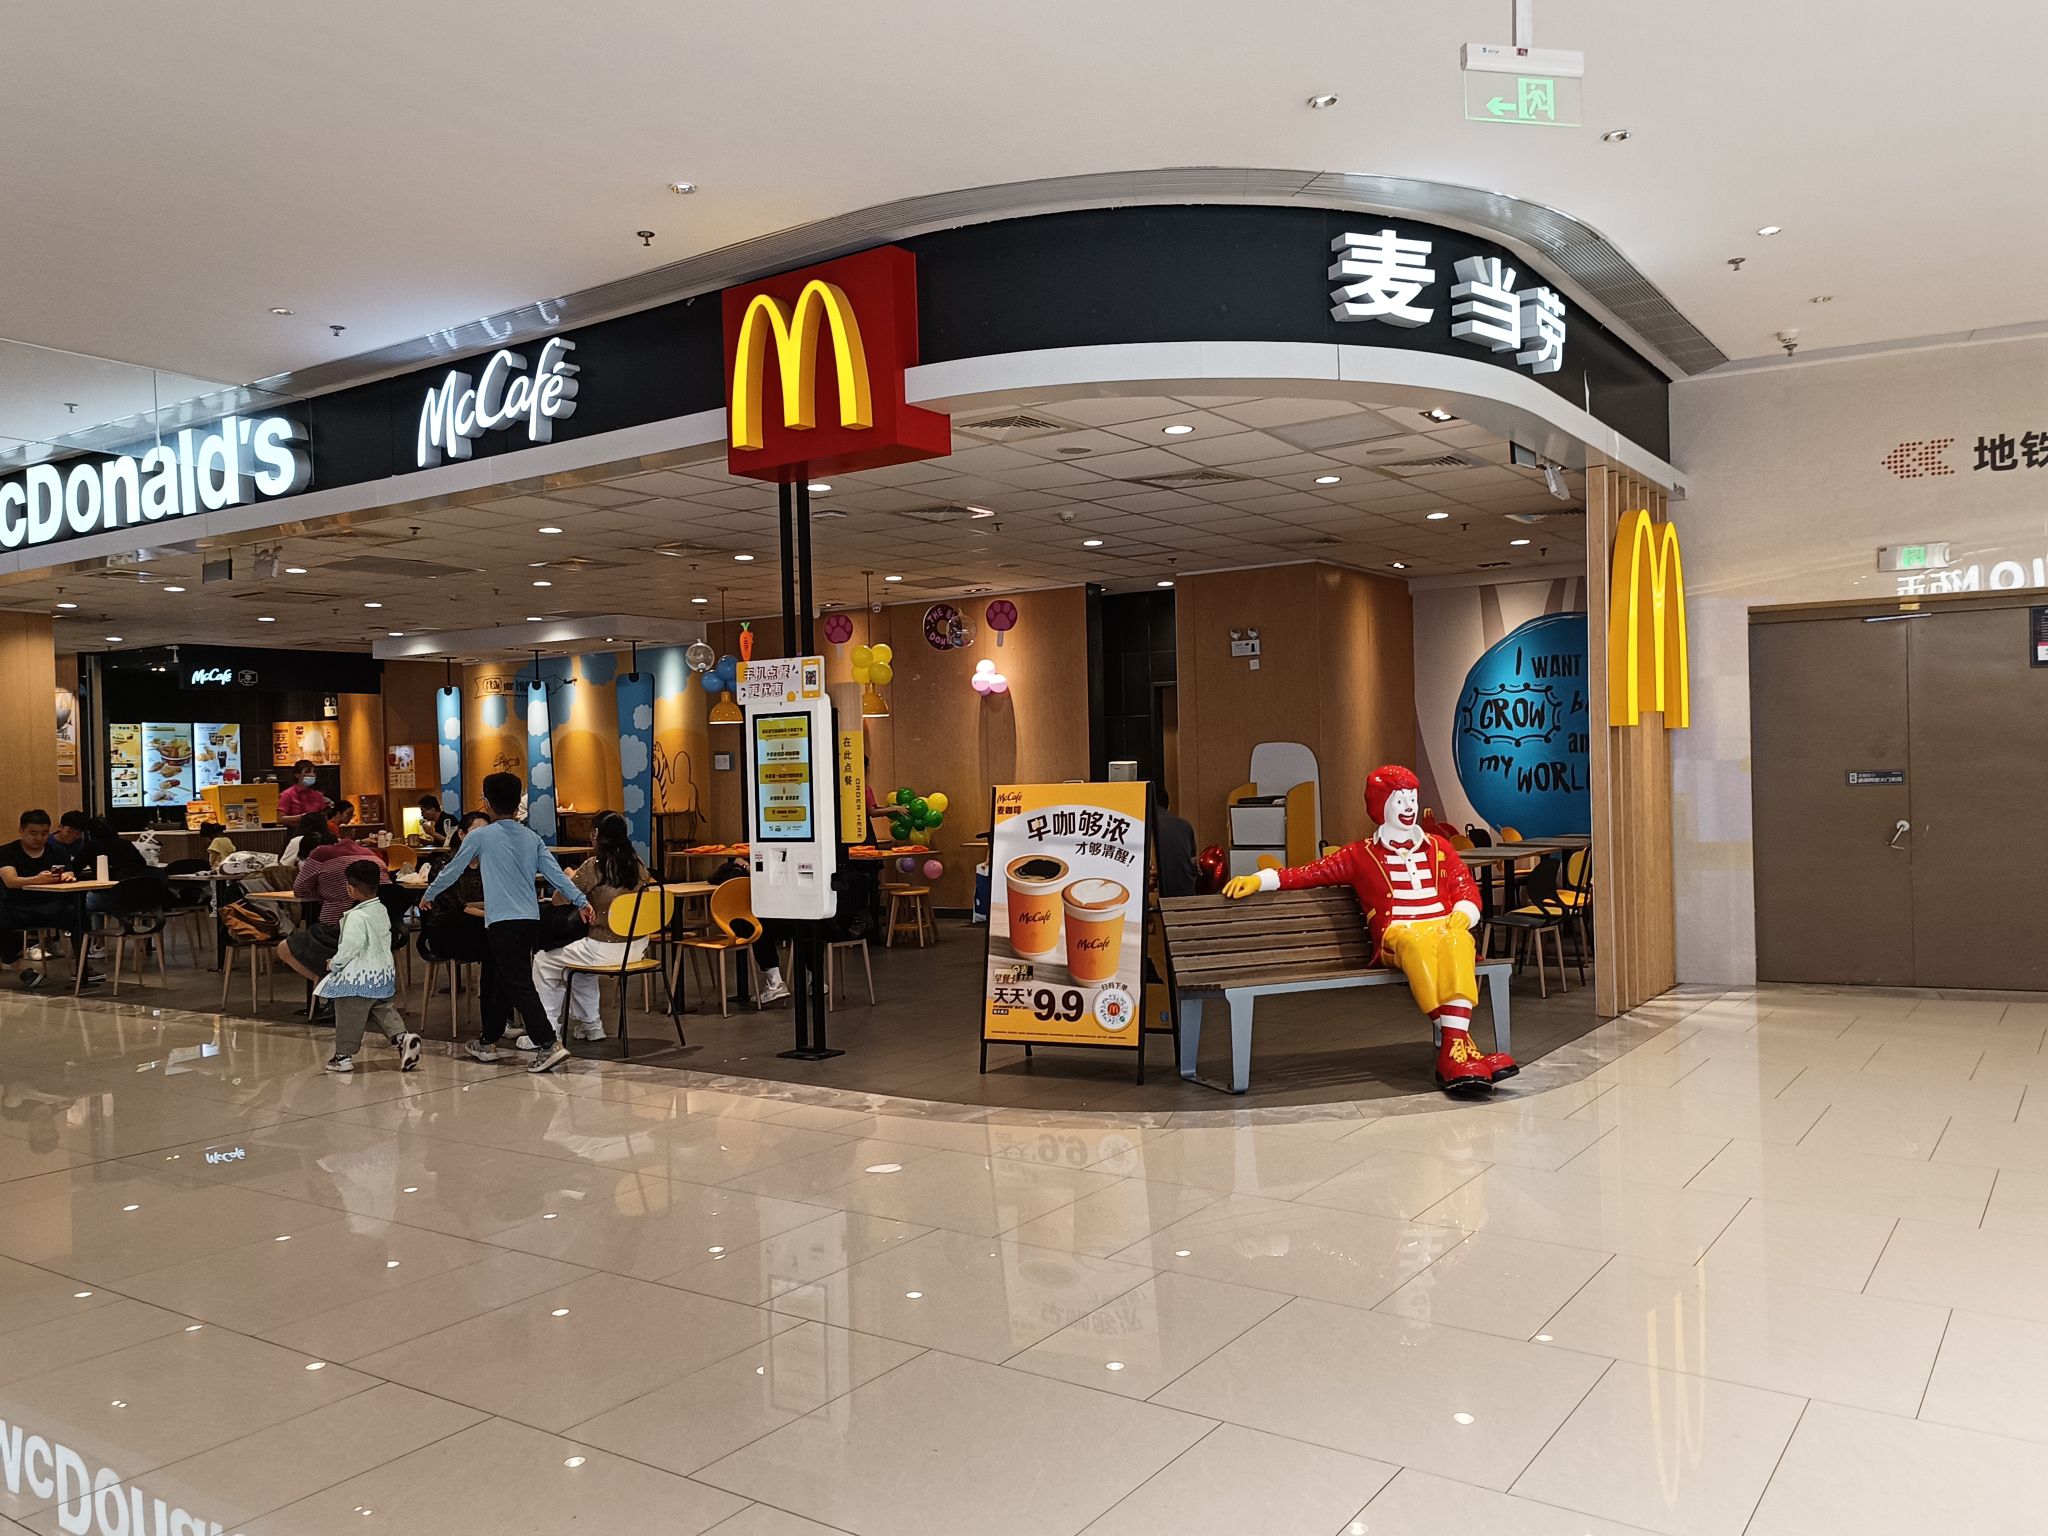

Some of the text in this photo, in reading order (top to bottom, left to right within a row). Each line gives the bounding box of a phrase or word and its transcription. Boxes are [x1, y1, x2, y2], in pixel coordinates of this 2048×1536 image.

[1329, 229, 1566, 374] 麦当劳
[417, 337, 574, 468] McCafé
[191, 668, 233, 685] McCafé
[1515, 646, 1582, 678] I WANT
[1479, 697, 1546, 731] GROW
[843, 737, 853, 786] 在此点餐
[1479, 755, 1591, 794] my WORL
[996, 791, 1022, 804] McCafé
[1027, 810, 1131, 845] 早咖够浓
[1019, 910, 1051, 924] McCafé
[1077, 937, 1110, 951] McCafé
[993, 987, 1025, 1005] 天天
